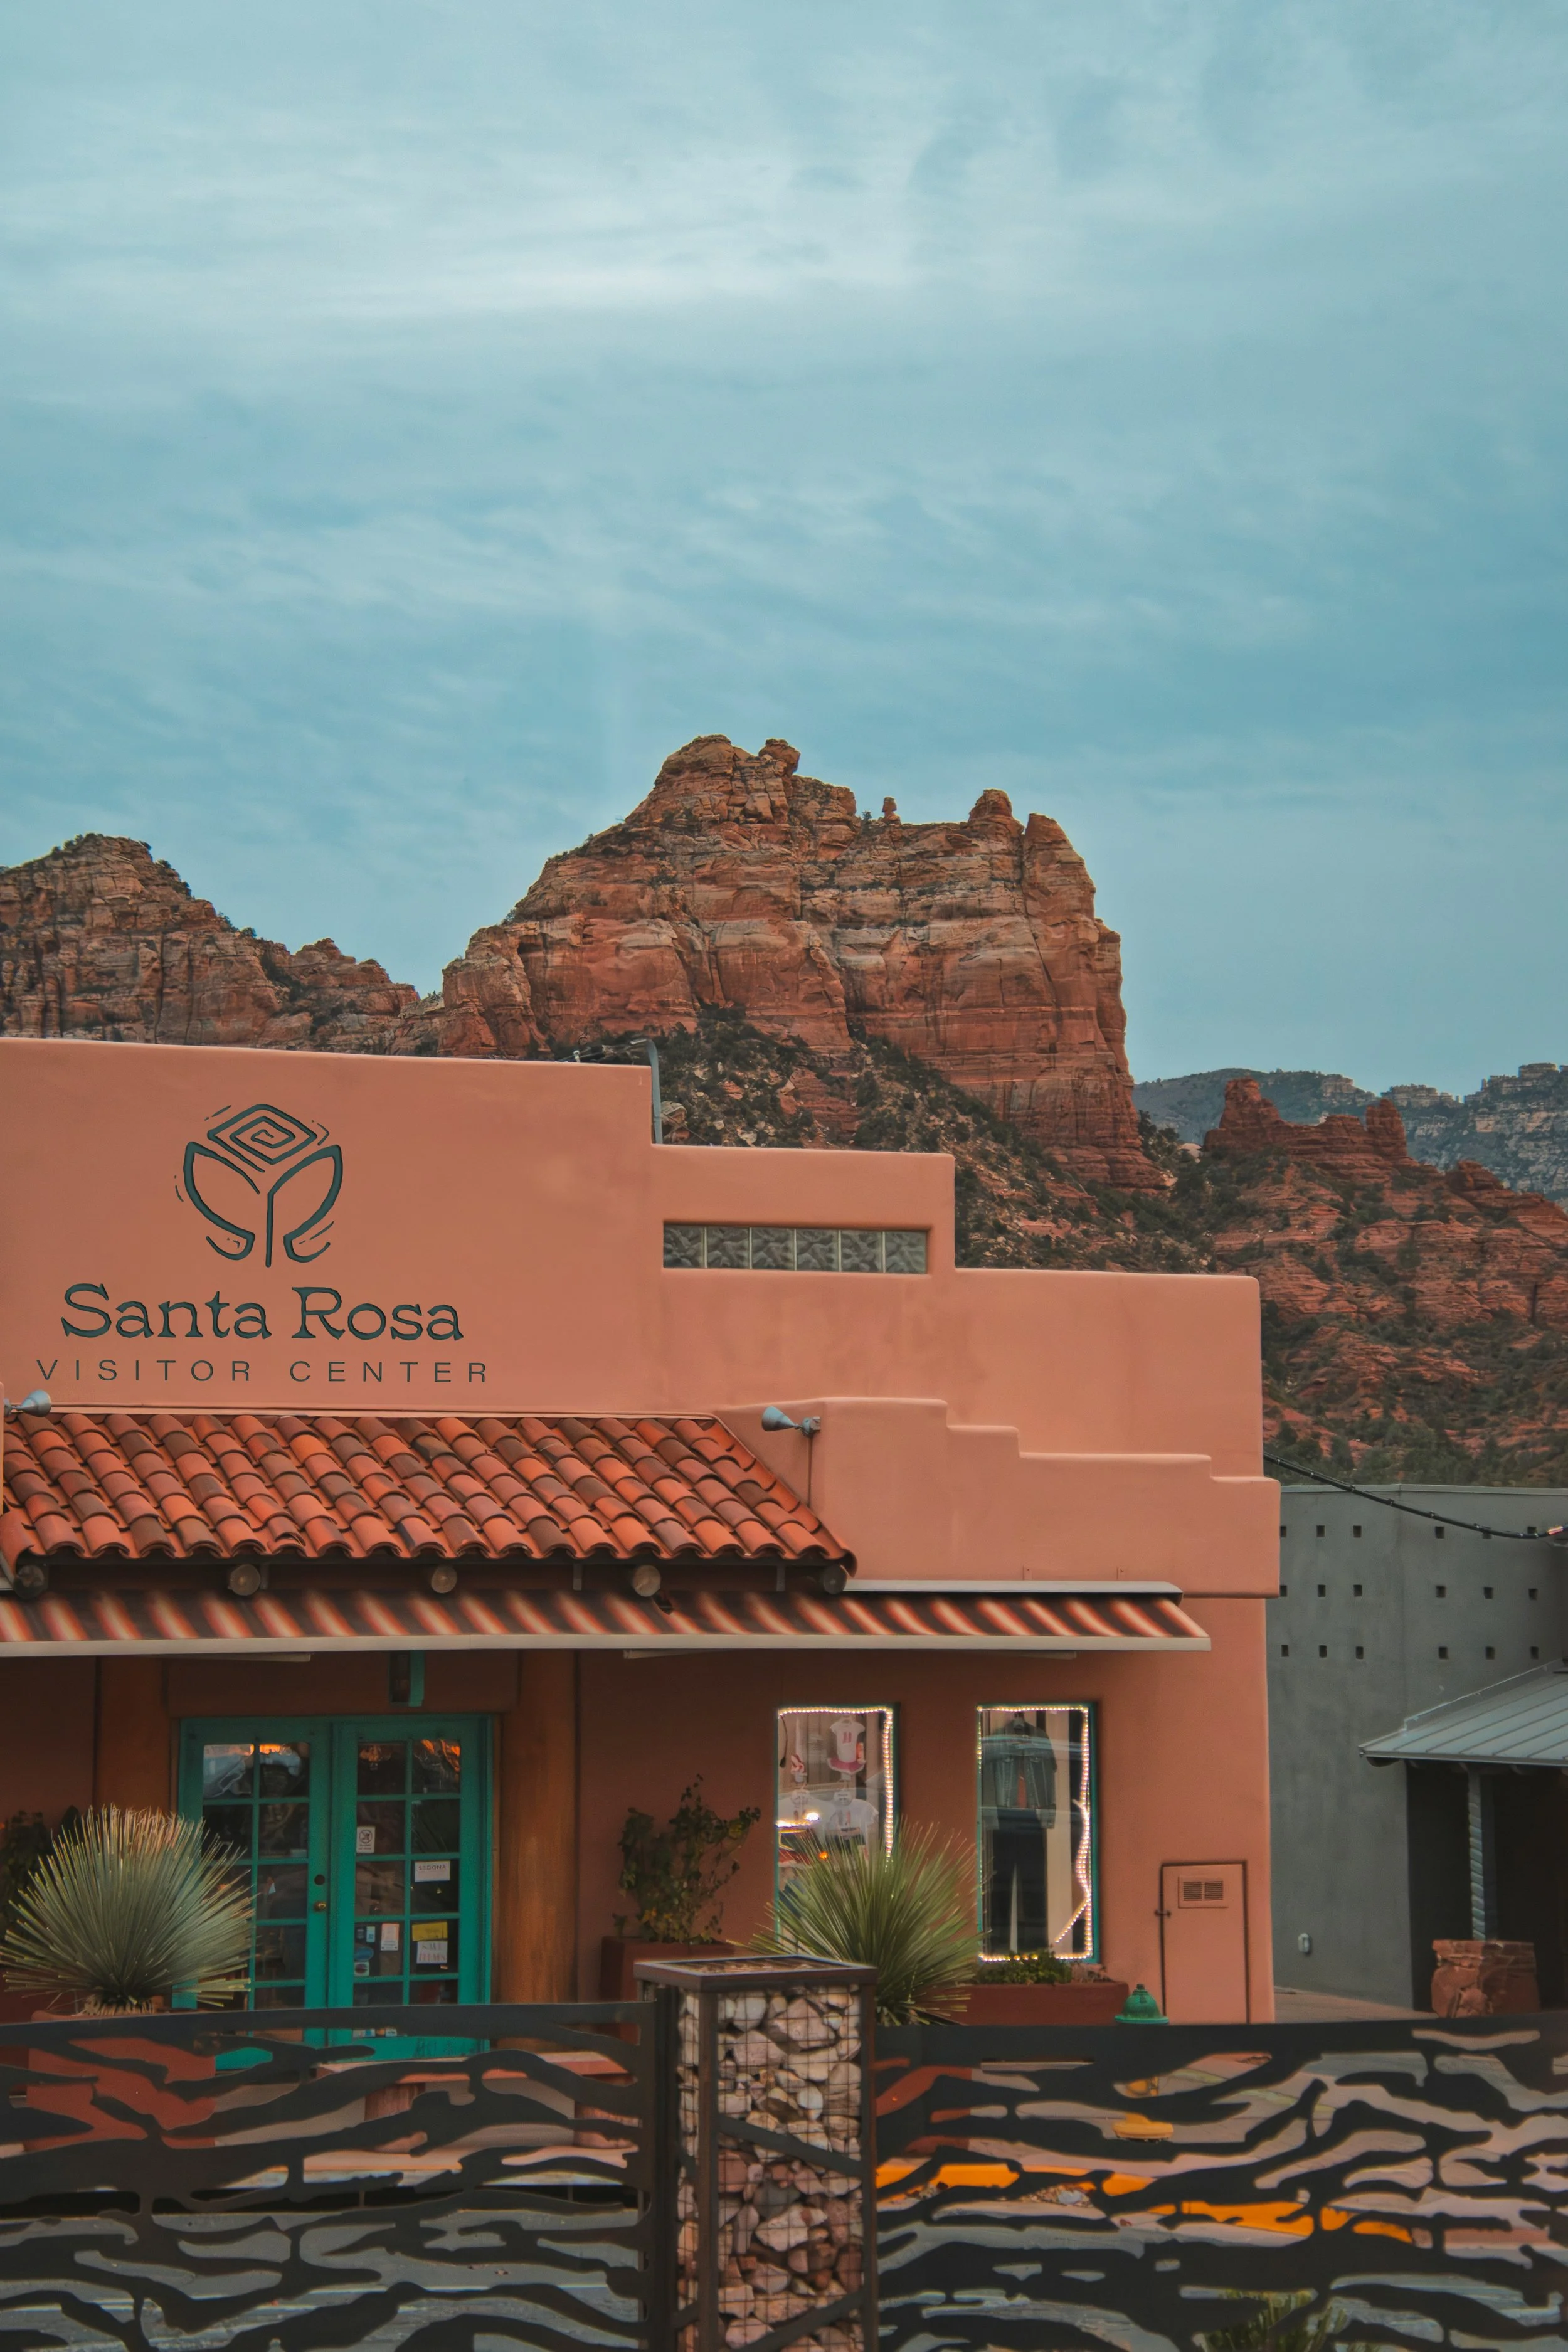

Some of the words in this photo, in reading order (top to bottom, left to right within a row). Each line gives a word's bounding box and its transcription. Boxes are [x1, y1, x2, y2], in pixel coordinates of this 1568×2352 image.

[60, 1283, 272, 1340] Santa
[291, 1286, 464, 1342] Rosa
[36, 1359, 250, 1382] VISITOR
[290, 1361, 487, 1383] CENTER
